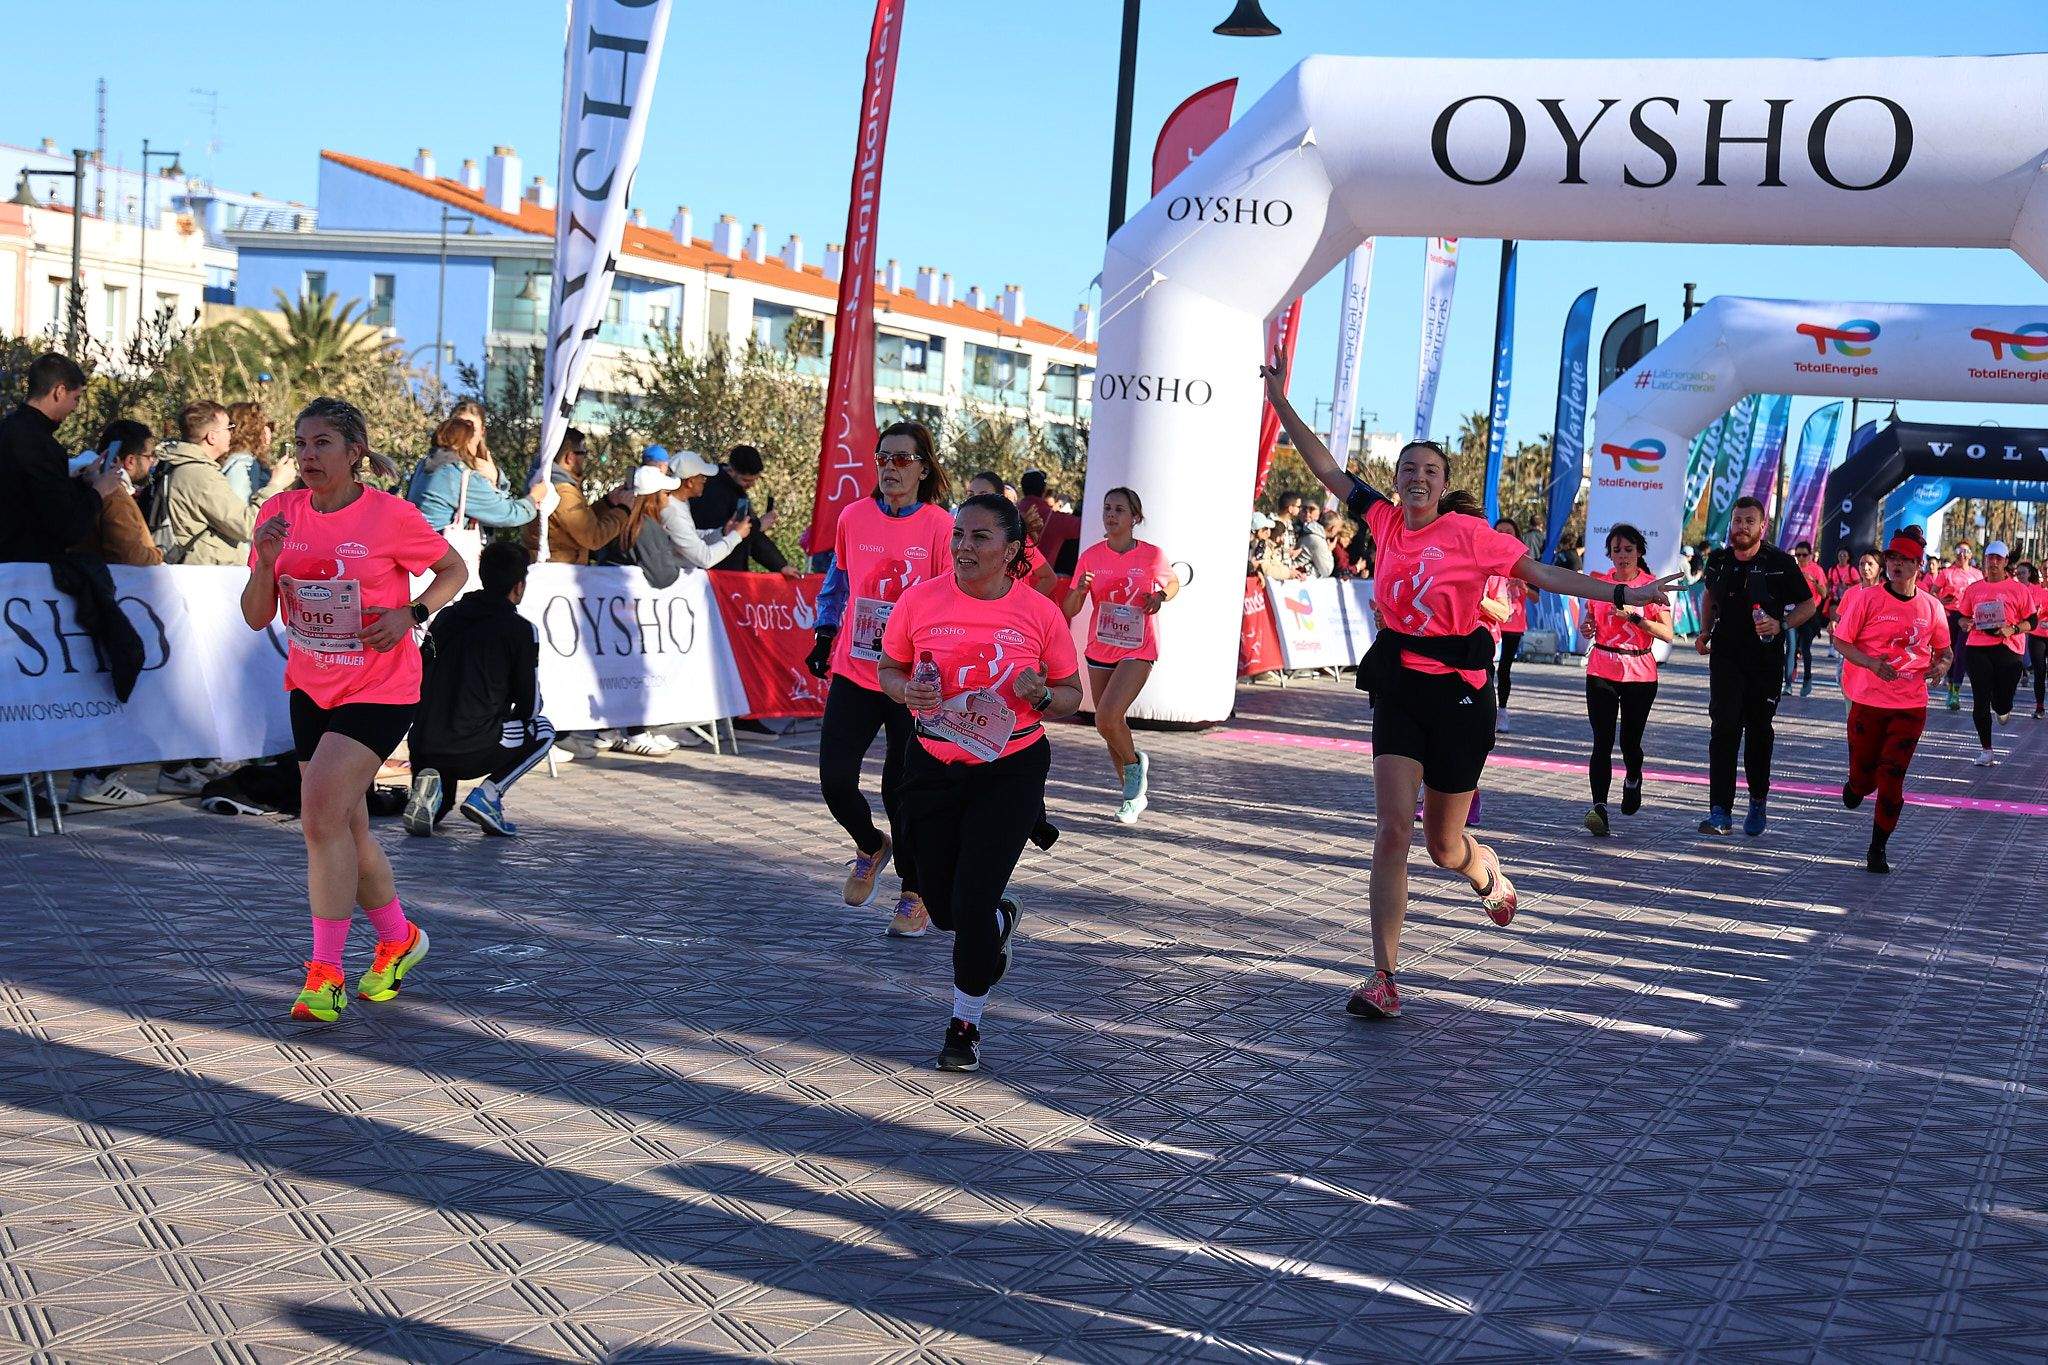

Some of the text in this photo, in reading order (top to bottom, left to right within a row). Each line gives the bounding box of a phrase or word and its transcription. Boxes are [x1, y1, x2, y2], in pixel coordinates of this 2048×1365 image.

[1430, 94, 1915, 192] OYSHO
[1166, 195, 1293, 227] OYSHO
[1793, 362, 1879, 377] TotalEnergies
[1100, 373, 1213, 406] OYSHO
[1557, 360, 1586, 468] Marlene
[1712, 394, 1755, 513] Batiste
[1598, 477, 1664, 491] TotalEnergies
[302, 610, 334, 625] 016
[542, 594, 696, 658] OYSHO
[731, 593, 794, 636] Sports
[929, 626, 967, 637] OYSHO
[335, 654, 365, 666] MUJER
